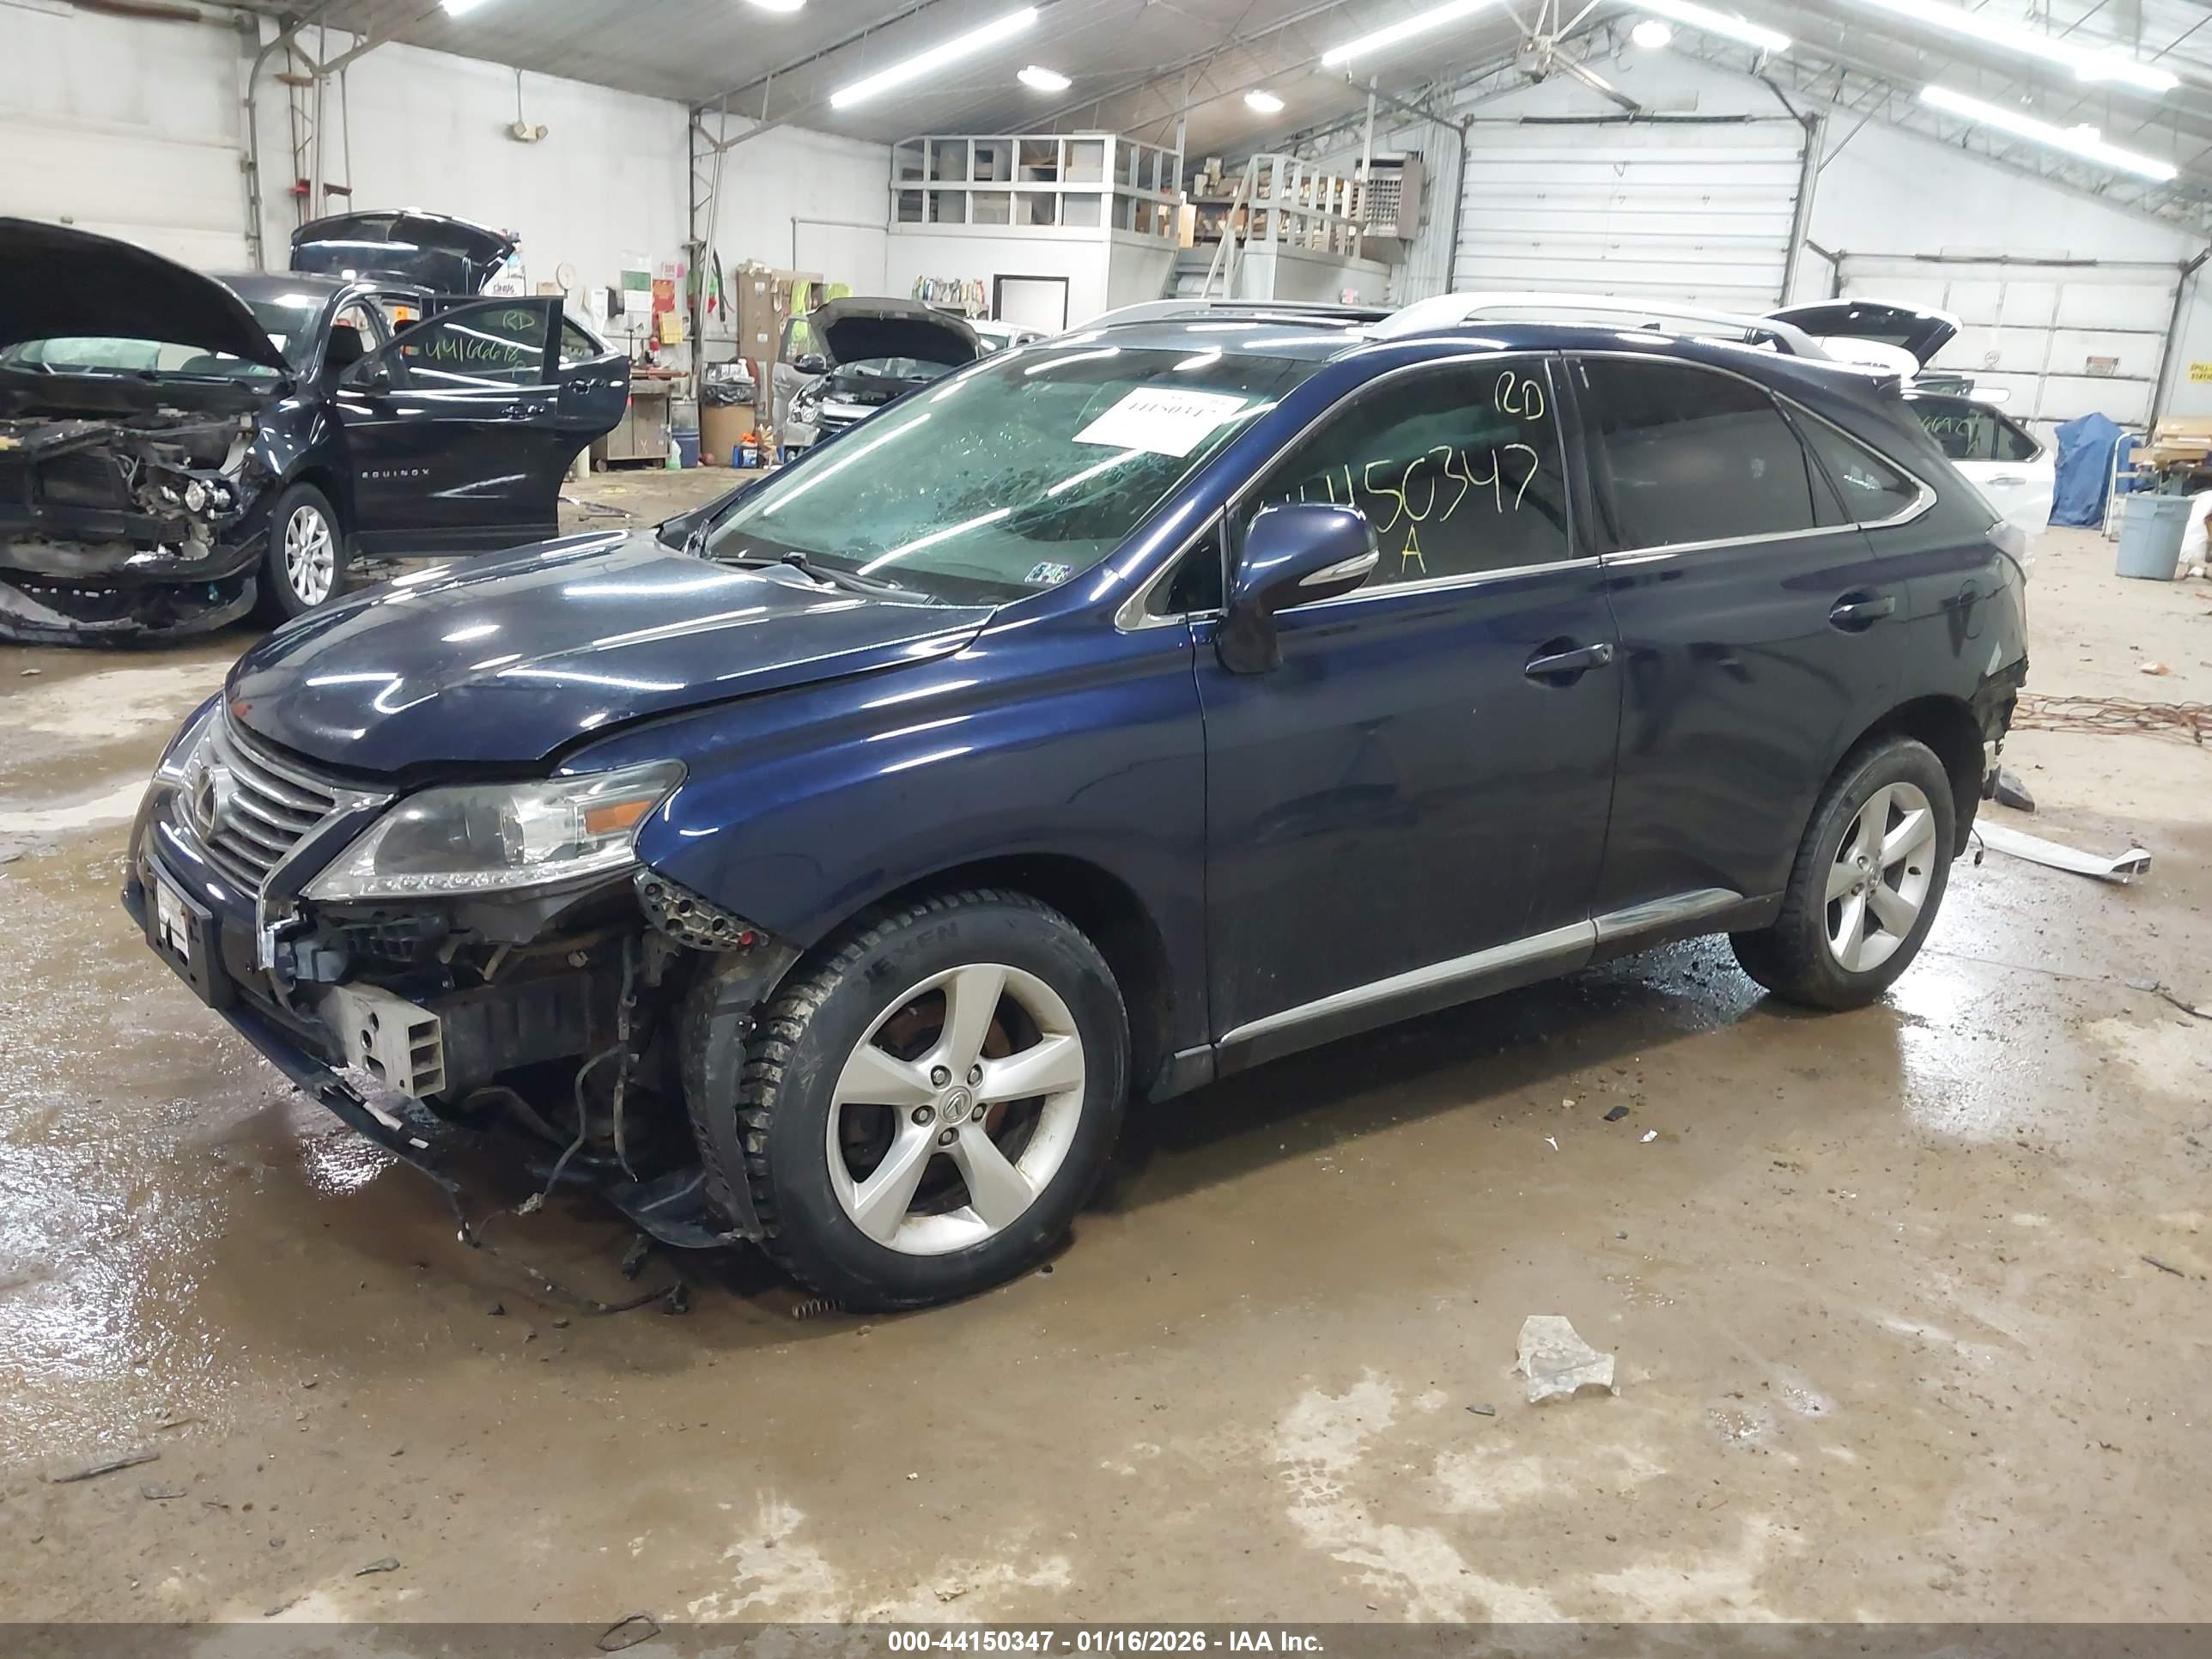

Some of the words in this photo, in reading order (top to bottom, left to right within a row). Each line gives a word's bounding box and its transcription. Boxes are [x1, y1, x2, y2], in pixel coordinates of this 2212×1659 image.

[502, 309, 536, 331] RD
[1494, 370, 1544, 421] RD
[362, 468, 429, 478] EQUINOX
[1260, 443, 1540, 534] 150347
[1401, 523, 1427, 574] A
